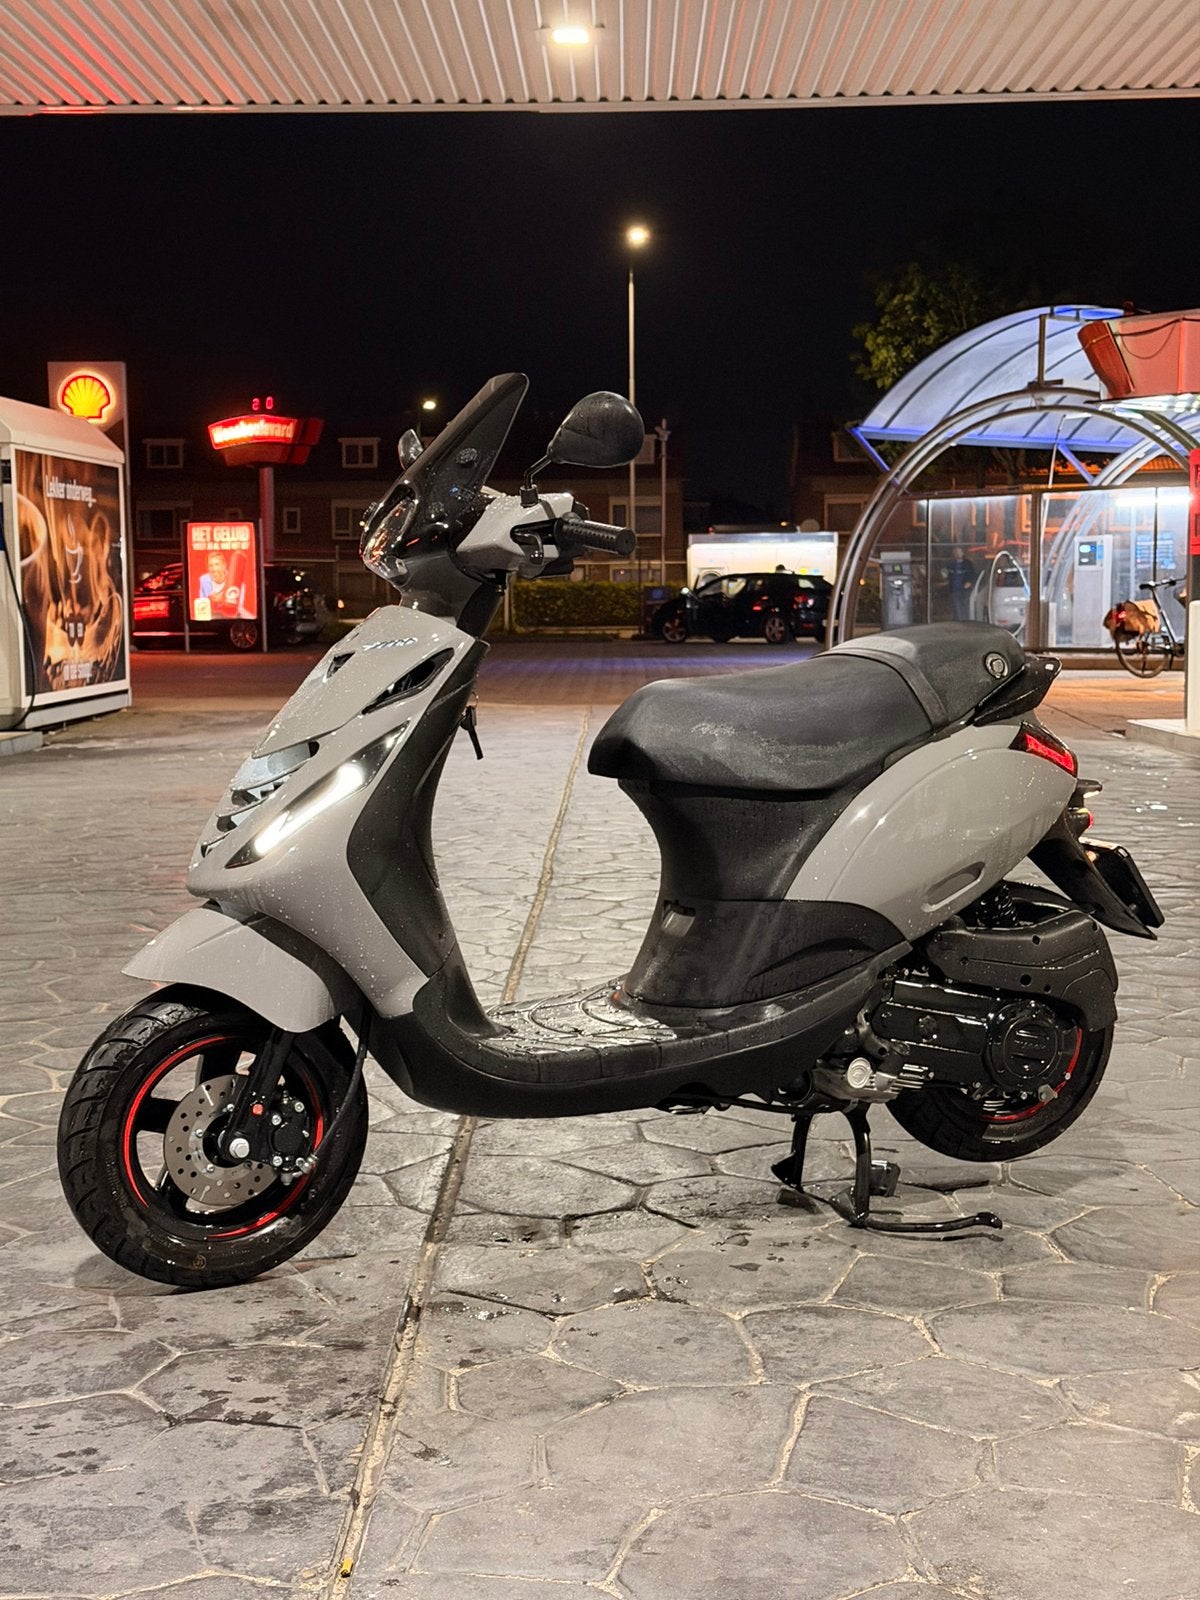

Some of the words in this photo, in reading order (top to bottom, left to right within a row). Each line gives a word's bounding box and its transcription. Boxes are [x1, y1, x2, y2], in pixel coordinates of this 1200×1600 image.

[45, 475, 66, 500] Lekker
[192, 526, 211, 542] HET
[213, 526, 250, 542] GELUID
